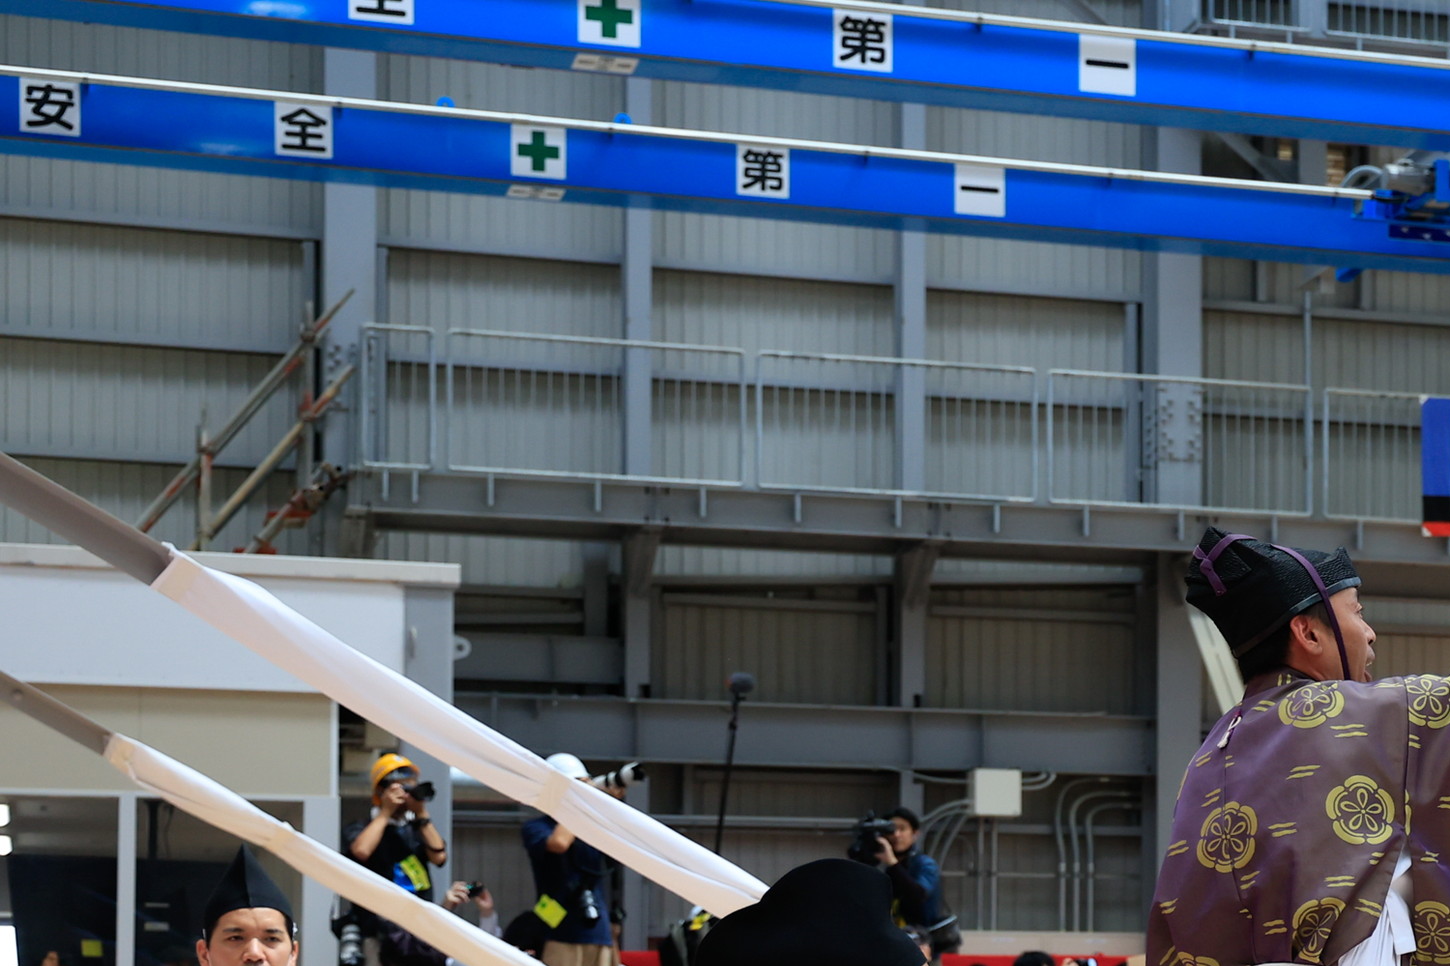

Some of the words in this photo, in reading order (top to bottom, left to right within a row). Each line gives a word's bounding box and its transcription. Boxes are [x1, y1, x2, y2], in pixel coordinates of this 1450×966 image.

[839, 16, 887, 64] 第
[24, 84, 75, 132] 安
[280, 108, 327, 152] 全
[742, 150, 784, 192] 第
